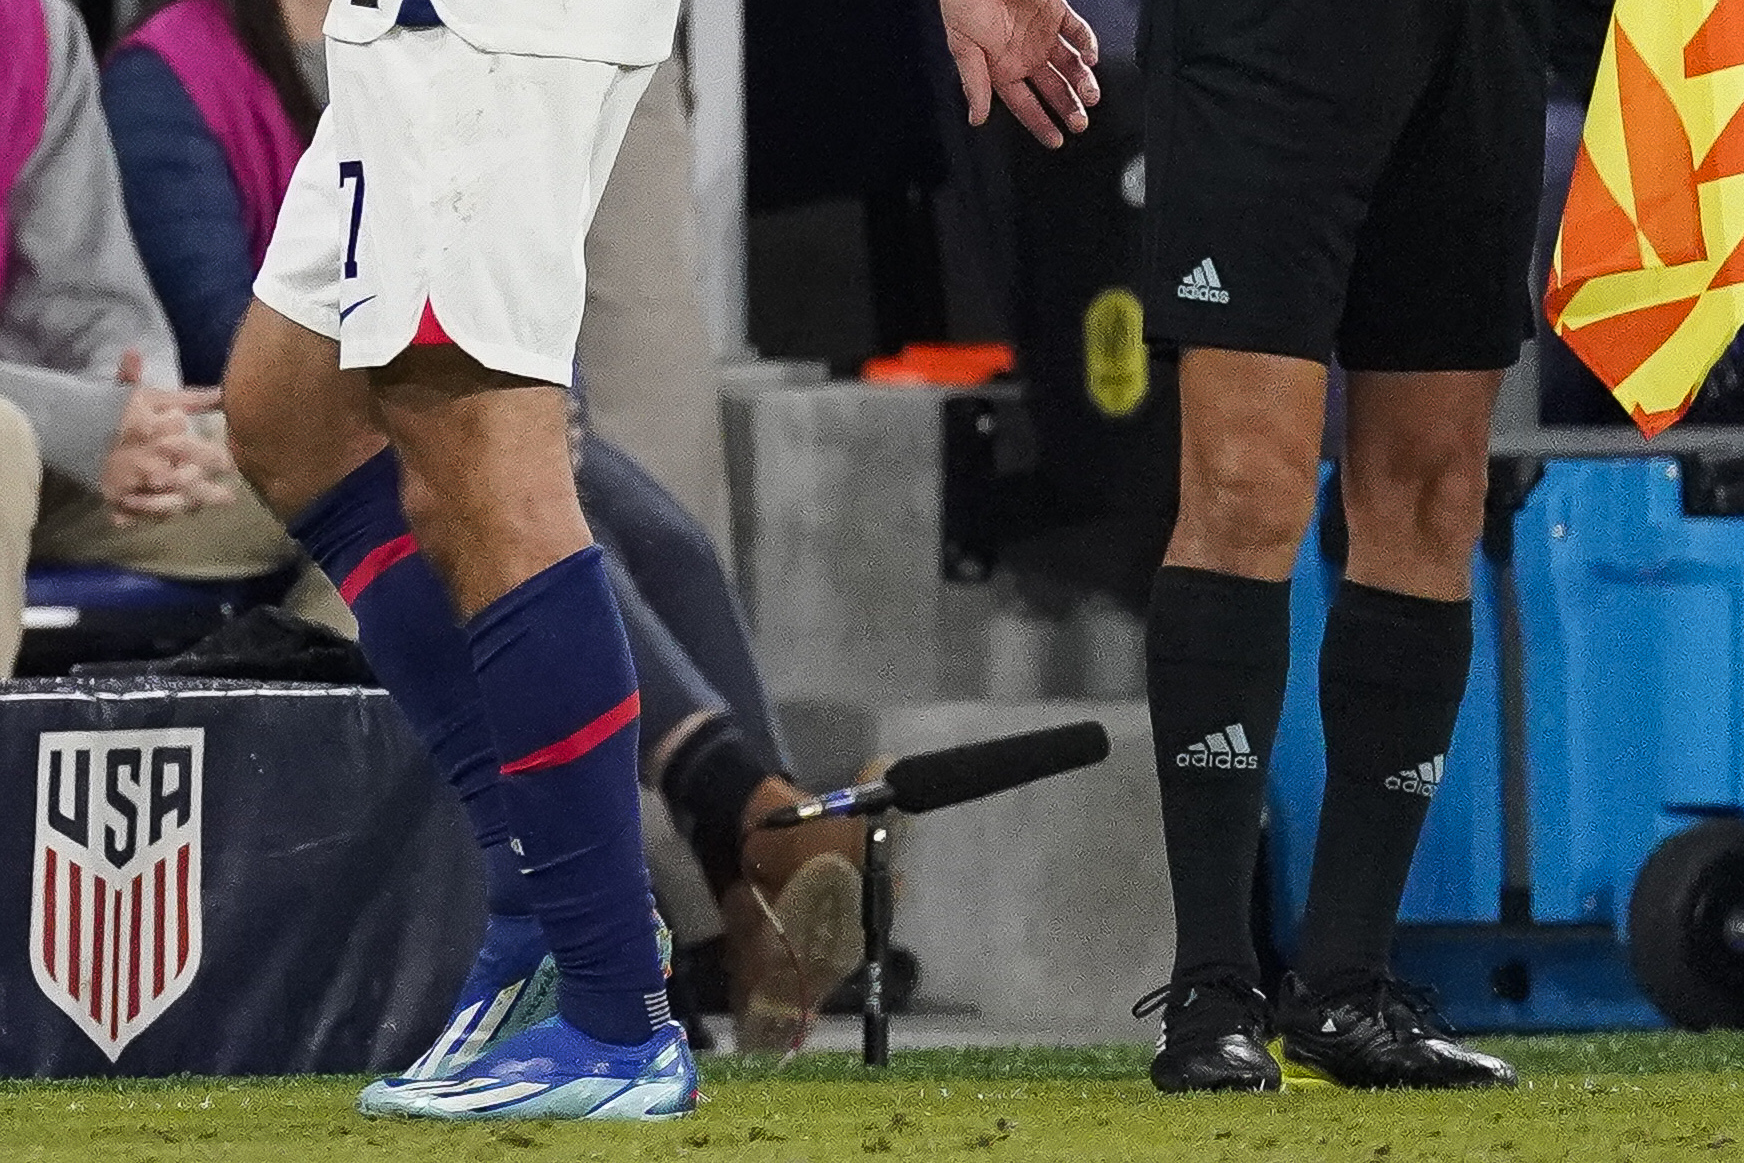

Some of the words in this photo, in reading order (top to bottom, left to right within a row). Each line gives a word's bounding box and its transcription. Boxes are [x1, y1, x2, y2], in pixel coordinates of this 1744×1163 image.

[340, 161, 365, 279] 7
[1177, 284, 1230, 304] adidas
[1176, 749, 1258, 769] adidas
[48, 746, 192, 870] USA
